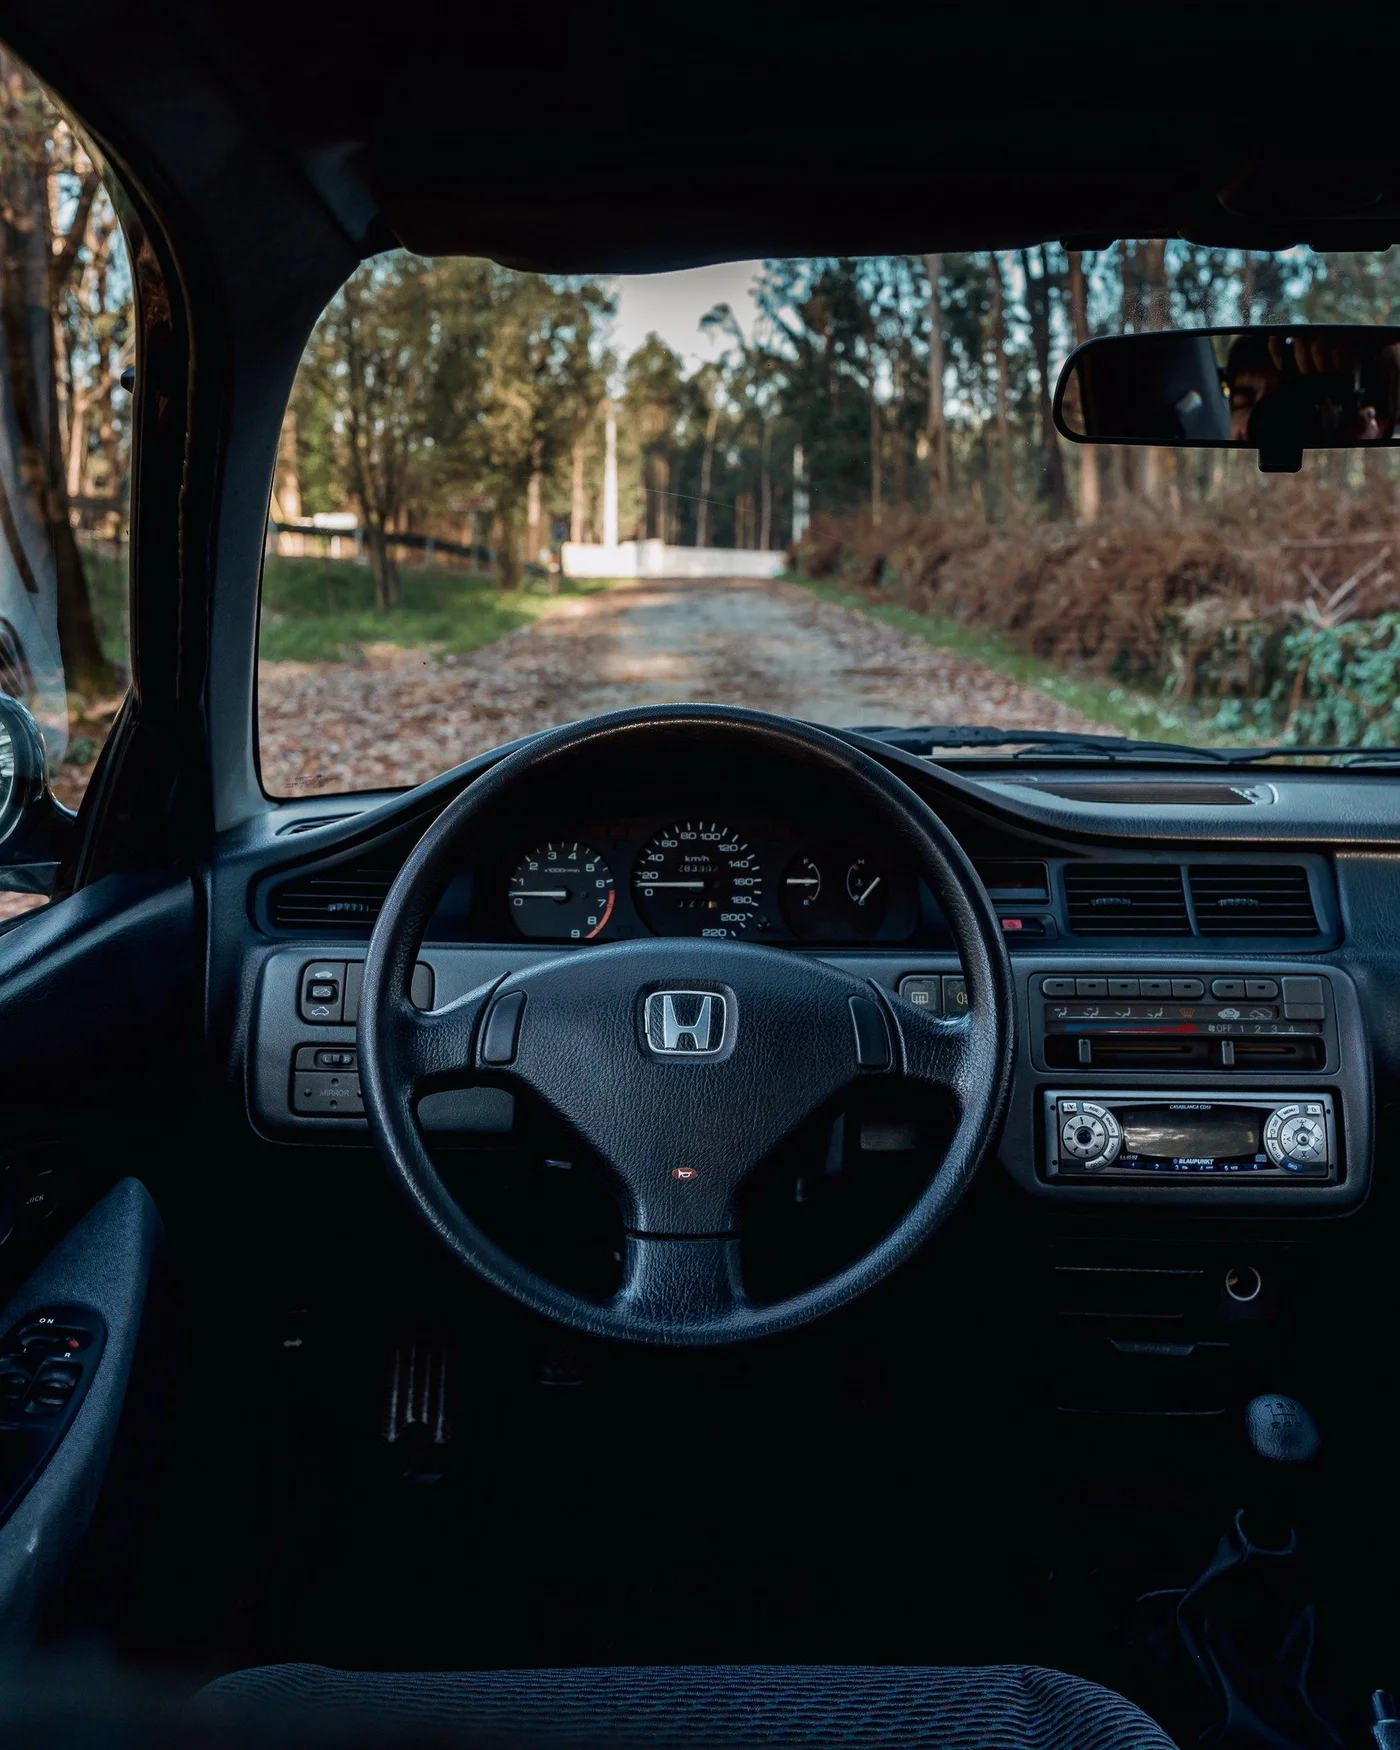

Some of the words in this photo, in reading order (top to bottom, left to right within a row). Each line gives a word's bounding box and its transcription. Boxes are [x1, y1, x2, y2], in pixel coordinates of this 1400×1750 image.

[680, 832, 697, 840] 80
[699, 833, 720, 841] 100
[661, 840, 678, 848] 60
[717, 844, 738, 852] 120
[548, 852, 557, 860] 3
[568, 852, 577, 860] 4
[647, 854, 664, 862] 40
[684, 855, 710, 863] km/h
[529, 862, 538, 870] 2
[586, 864, 595, 872] 5
[728, 860, 749, 868] 140
[642, 871, 659, 879] 20
[518, 878, 524, 886] 1
[596, 880, 605, 888] 6
[733, 878, 754, 886] 160
[644, 889, 653, 897] 0
[513, 898, 523, 906] 0
[597, 899, 606, 907] 7
[731, 896, 752, 904] 180
[588, 916, 597, 925] 8
[721, 913, 746, 921] 200
[571, 929, 580, 938] 9
[702, 929, 727, 937] 220
[1216, 1024, 1232, 1033] OFF
[1255, 1025, 1261, 1033] 2
[1272, 1025, 1278, 1033] 3
[1288, 1025, 1295, 1033] 4
[319, 1089, 350, 1097] MIRROR
[39, 1317, 54, 1325] ON
